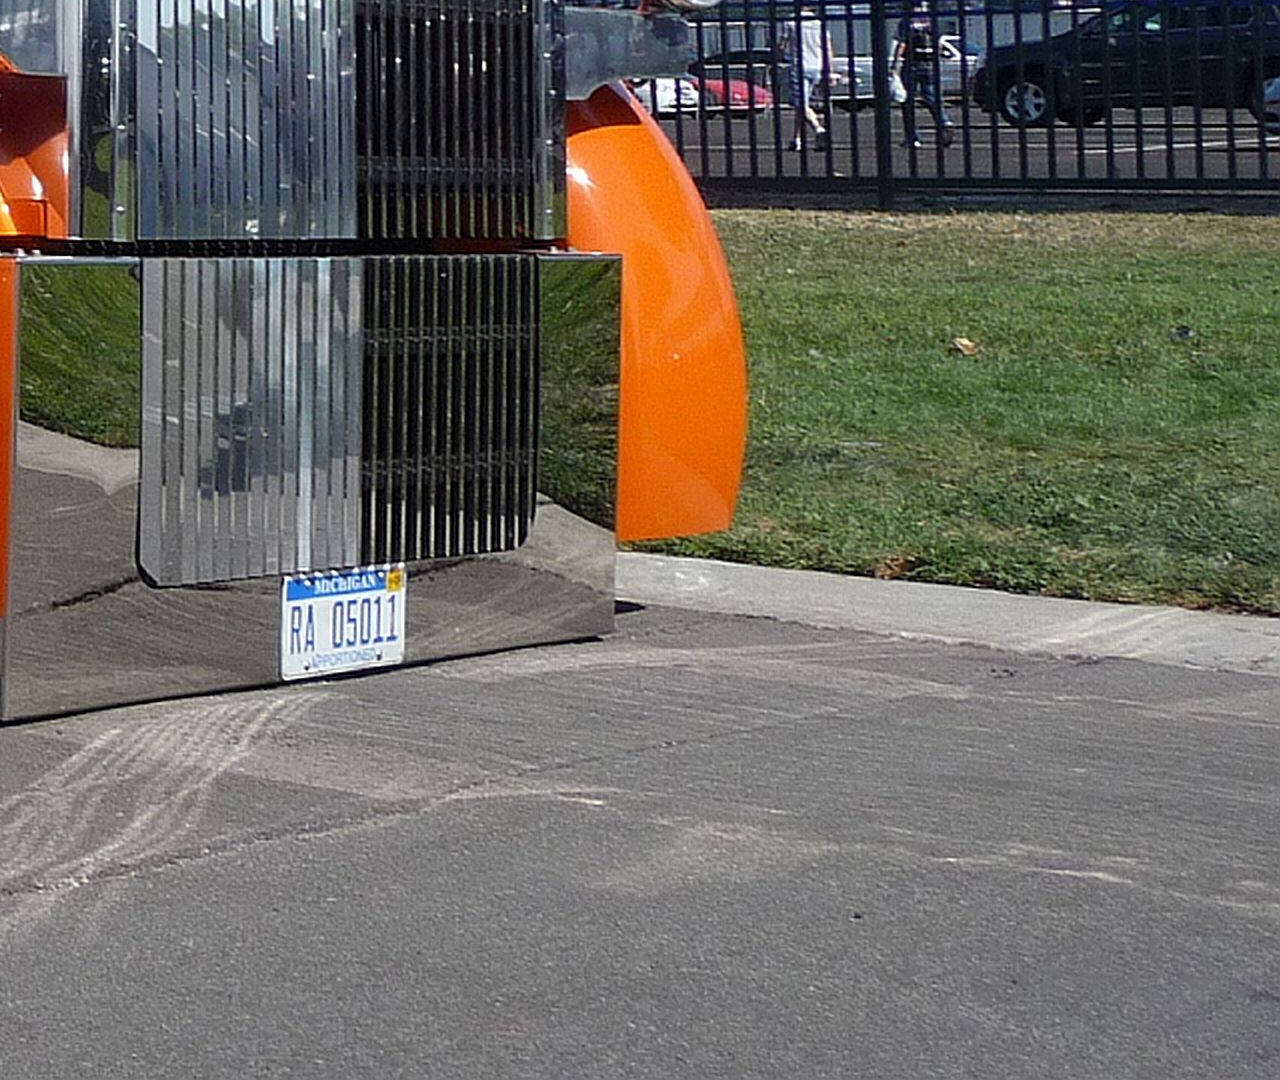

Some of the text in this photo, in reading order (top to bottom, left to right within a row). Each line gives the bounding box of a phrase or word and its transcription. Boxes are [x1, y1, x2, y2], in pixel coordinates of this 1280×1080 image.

[314, 573, 377, 595] MICHIGAN
[290, 595, 398, 655] RA 05011
